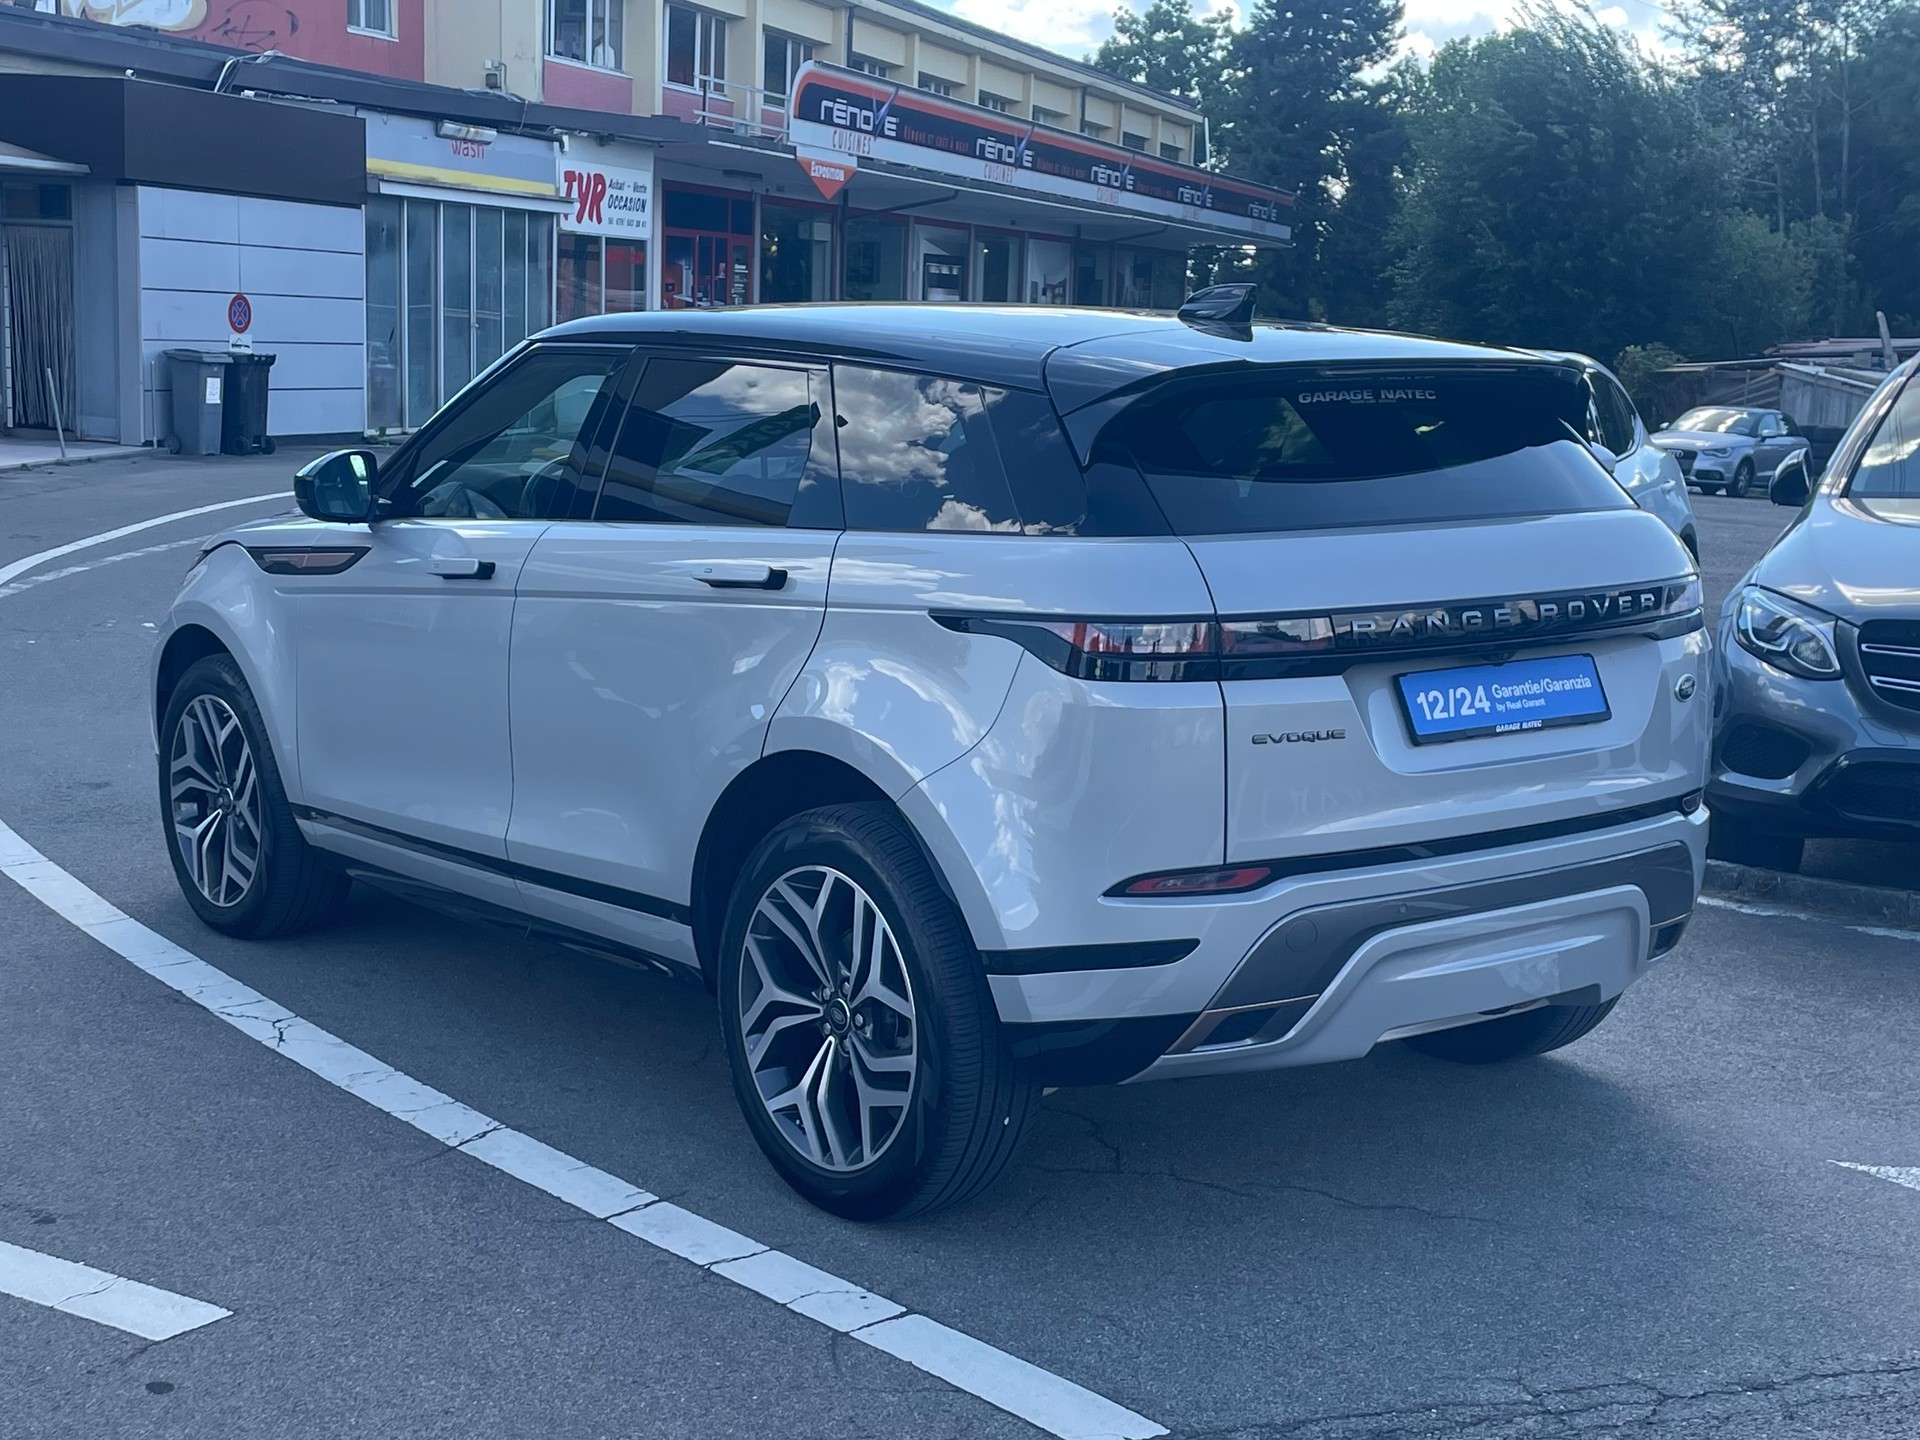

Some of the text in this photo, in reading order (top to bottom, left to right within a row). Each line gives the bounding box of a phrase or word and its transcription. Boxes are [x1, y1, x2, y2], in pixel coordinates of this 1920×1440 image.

[832, 129, 872, 155] CUISINES
[564, 170, 606, 225] TYR
[607, 194, 647, 213] OCCASION
[1298, 389, 1436, 404] GARAGE NATEC
[1350, 593, 1655, 639] RANGE ROVER
[1417, 674, 1592, 721] 12/24 Garantie/Garanzia
[1496, 698, 1546, 713] by Real Garant
[1251, 729, 1346, 745] EVOQUE
[1496, 722, 1520, 733] GARAGE
